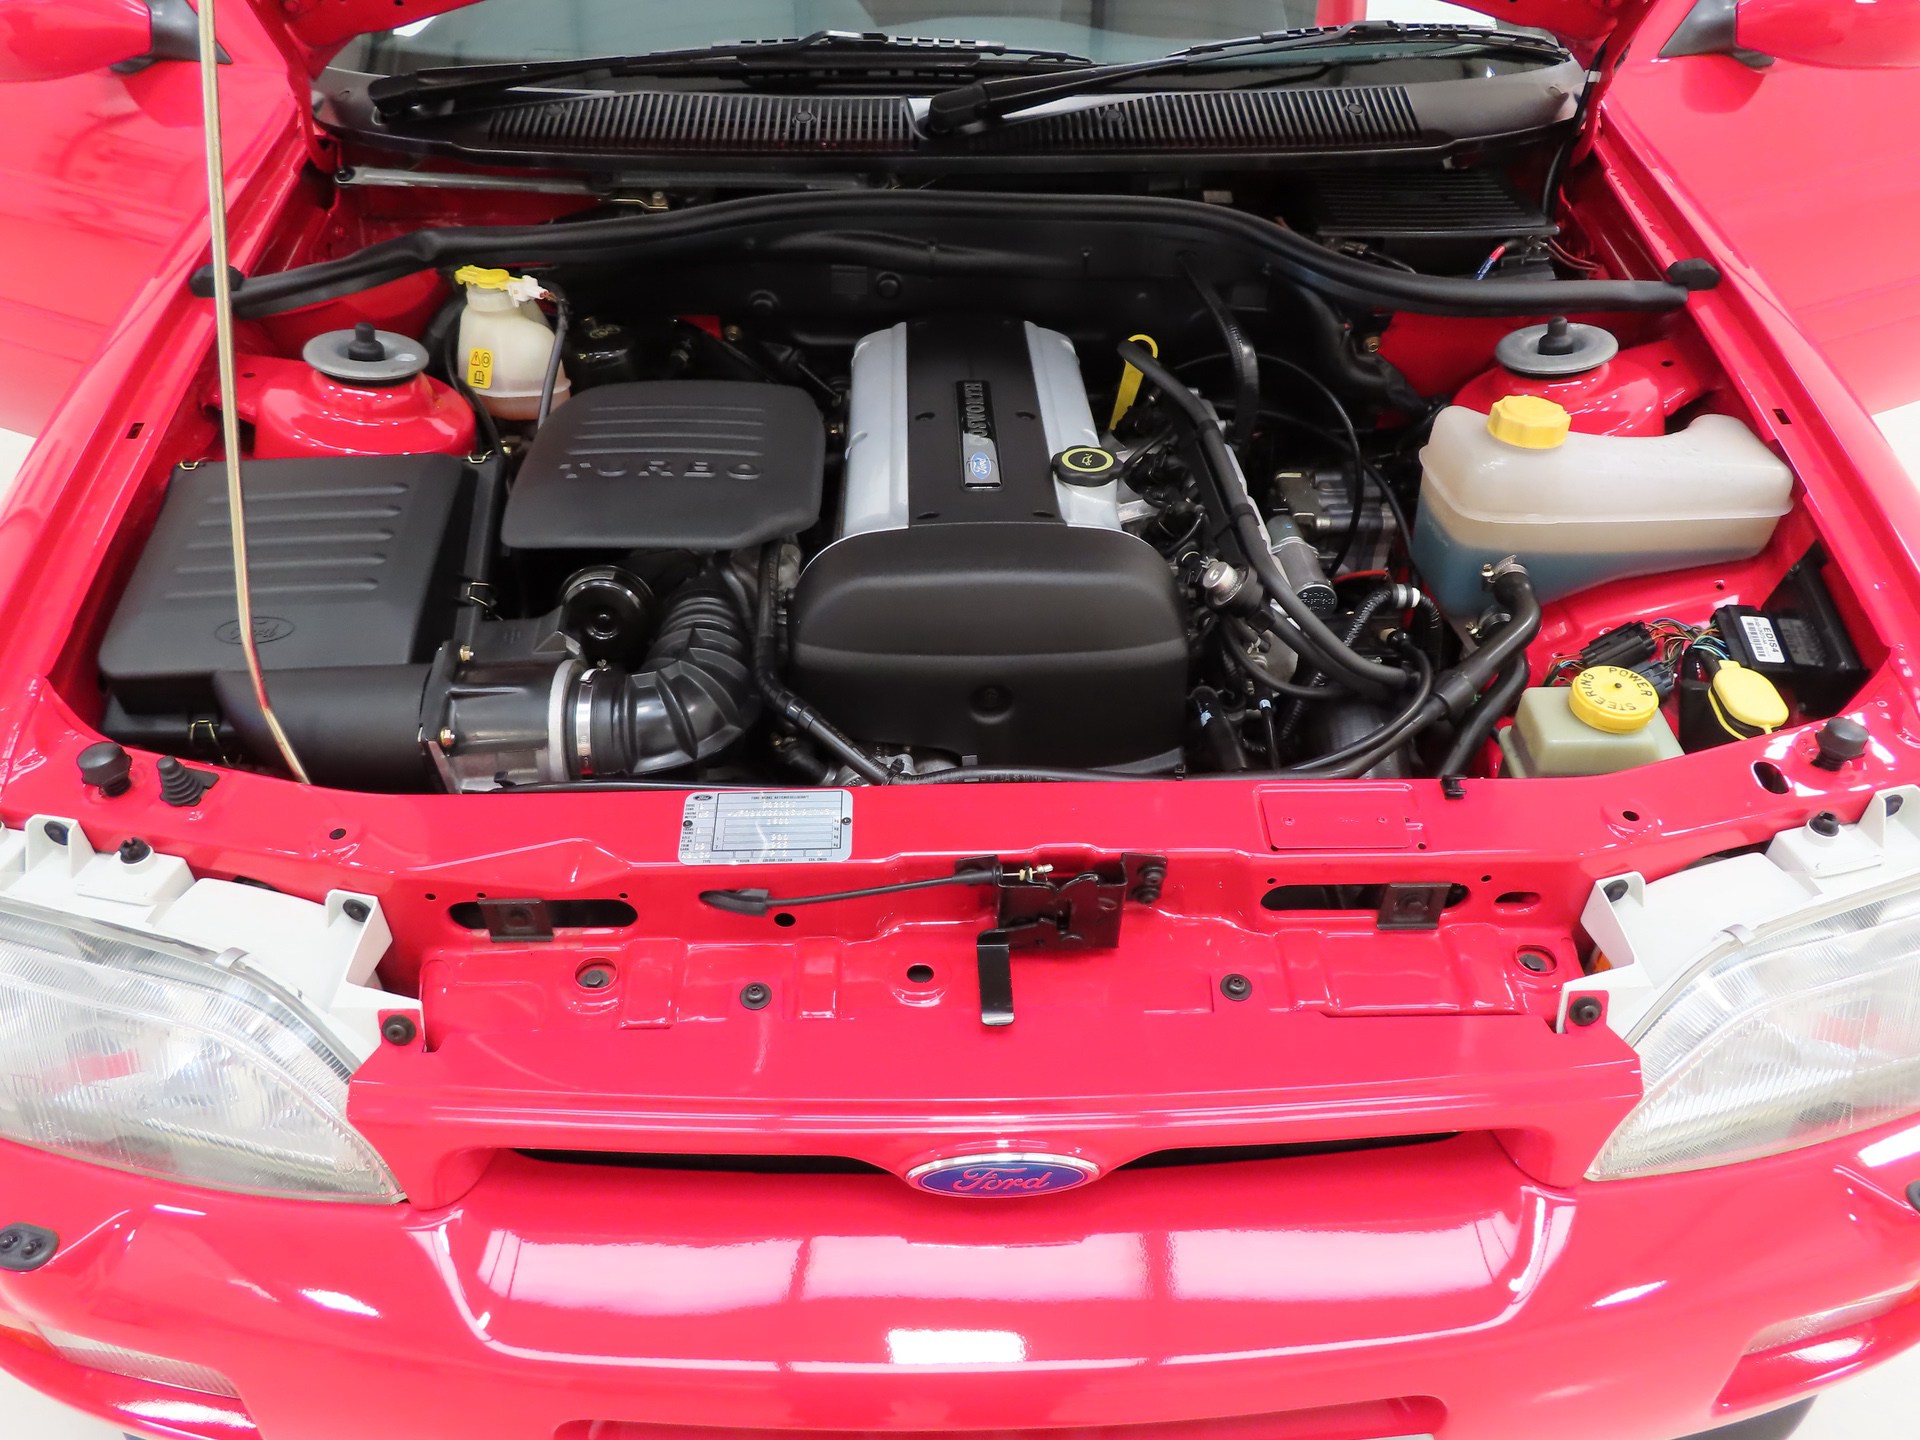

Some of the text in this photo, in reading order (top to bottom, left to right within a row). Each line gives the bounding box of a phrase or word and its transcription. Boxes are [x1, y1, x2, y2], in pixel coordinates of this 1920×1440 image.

[559, 459, 762, 480] TURBO
[1763, 627, 1780, 653] EDIS4
[1580, 672, 1637, 712] STEERING
[1608, 667, 1653, 697] POWER
[952, 1167, 1053, 1191] Ford
